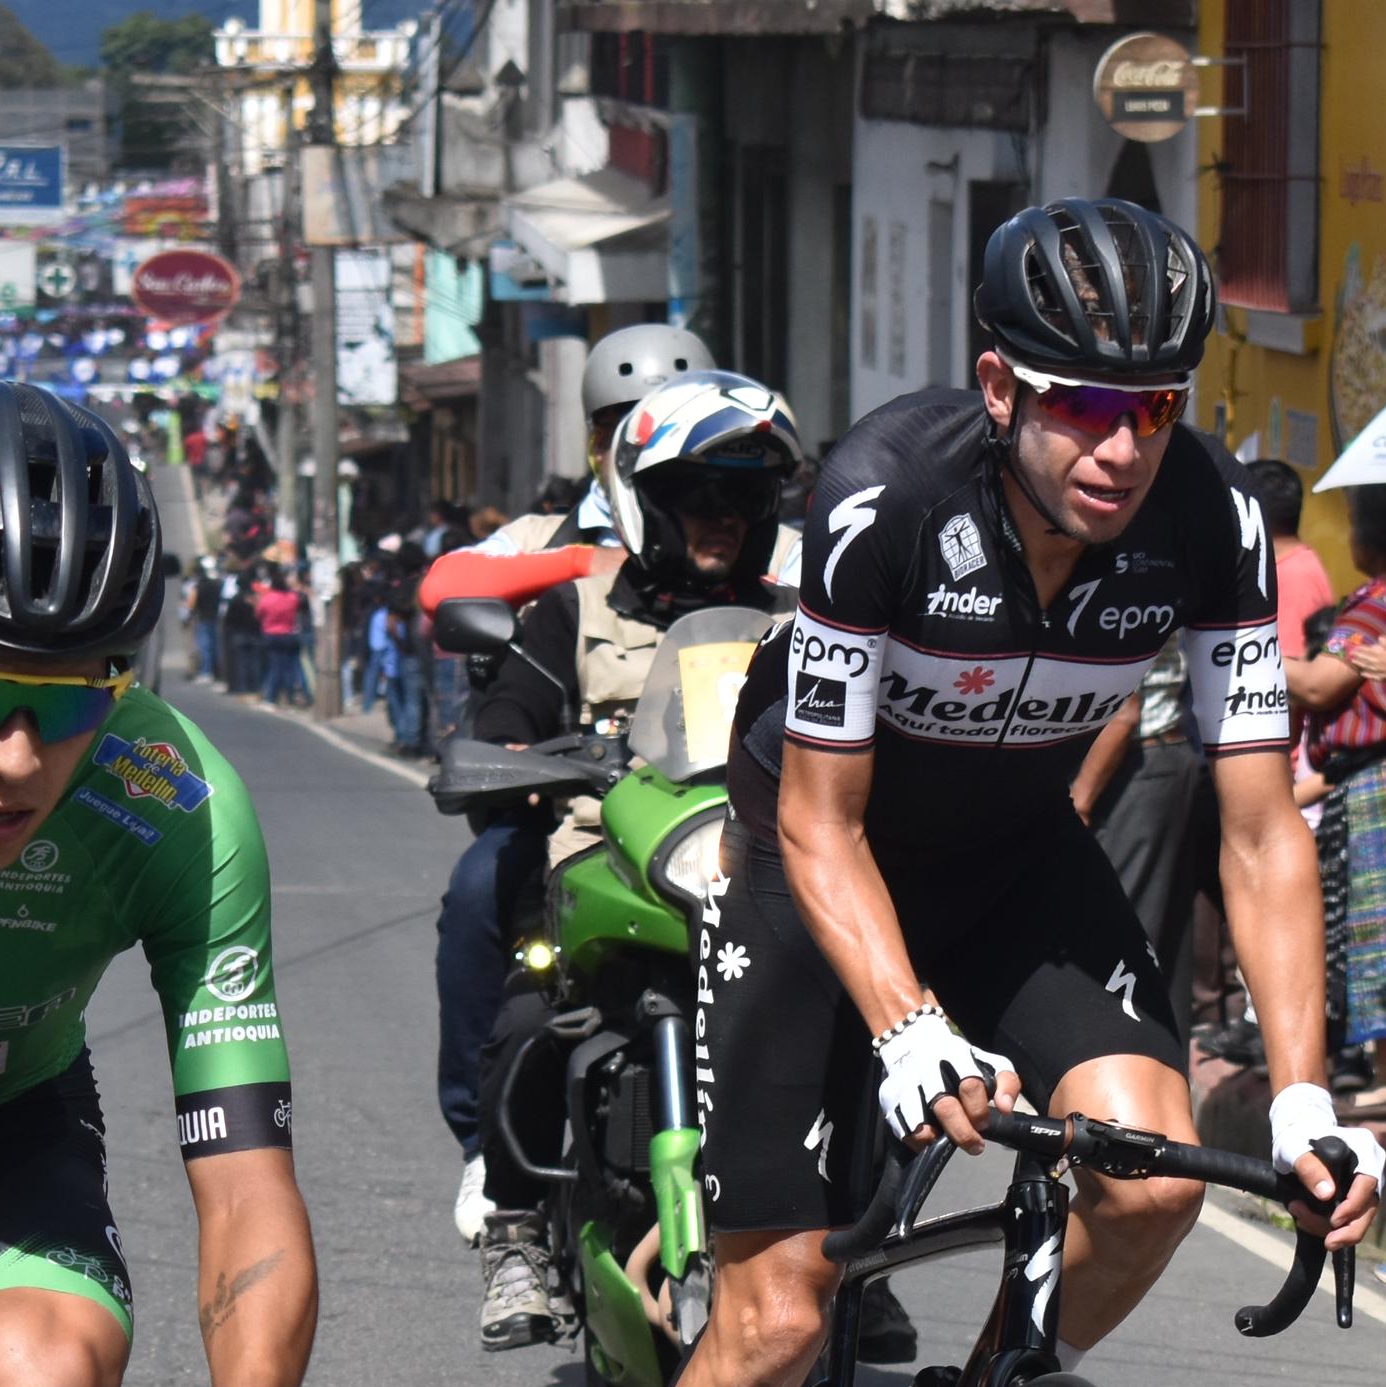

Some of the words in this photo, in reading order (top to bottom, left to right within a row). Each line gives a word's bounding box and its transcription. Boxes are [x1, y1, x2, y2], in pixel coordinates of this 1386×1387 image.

[1099, 605, 1174, 640] epm
[793, 627, 870, 678] epm
[939, 723, 998, 737] todo
[142, 761, 161, 776] de
[179, 1003, 278, 1029] INDEPORTES
[184, 1024, 280, 1049] ANTIOQUIA
[1125, 1132, 1155, 1143] GARMIN
